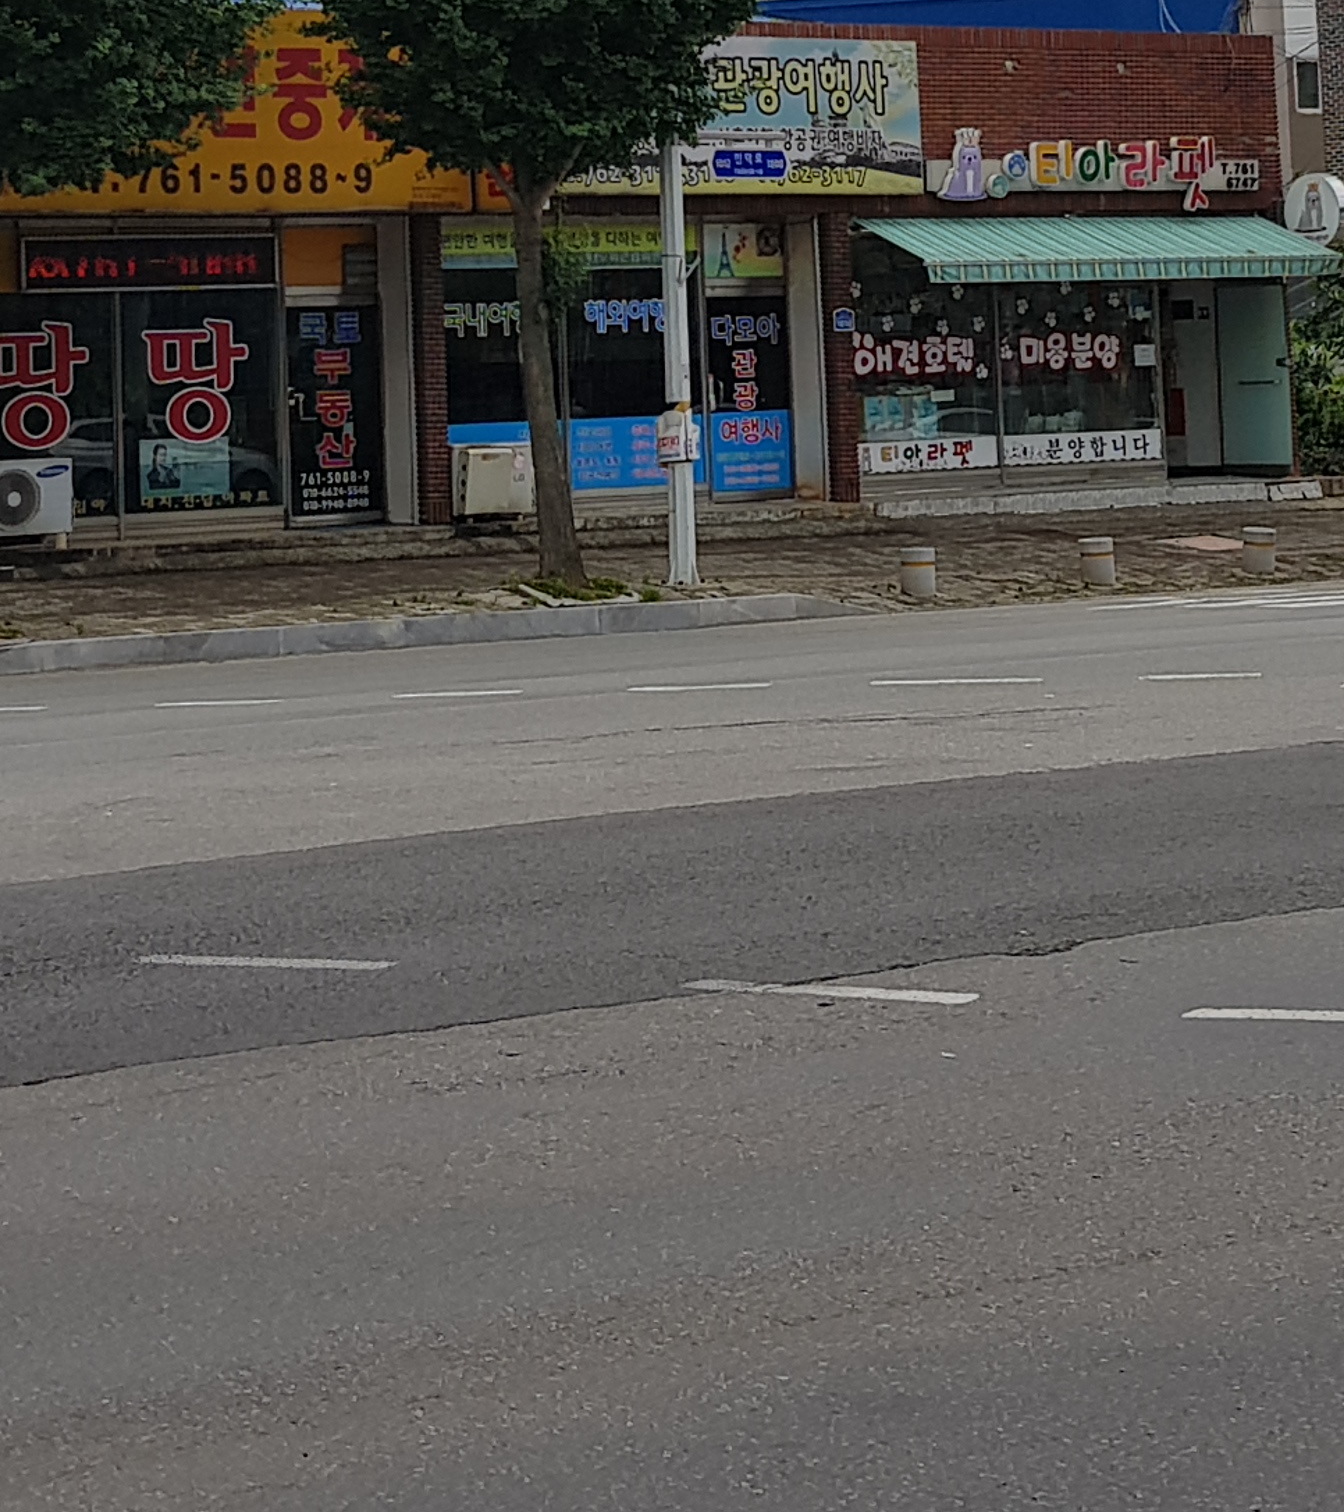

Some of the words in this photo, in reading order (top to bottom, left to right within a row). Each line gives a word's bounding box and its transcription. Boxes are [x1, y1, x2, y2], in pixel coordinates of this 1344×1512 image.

[711, 57, 890, 116] 관광여행사
[710, 314, 780, 346] 다모아
[853, 334, 975, 376] 애견호텔
[142, 318, 249, 443] 땅
[720, 417, 783, 445] 여행사
[1046, 434, 1151, 459] 분양합니다
[300, 470, 370, 486] 761-5088-9
